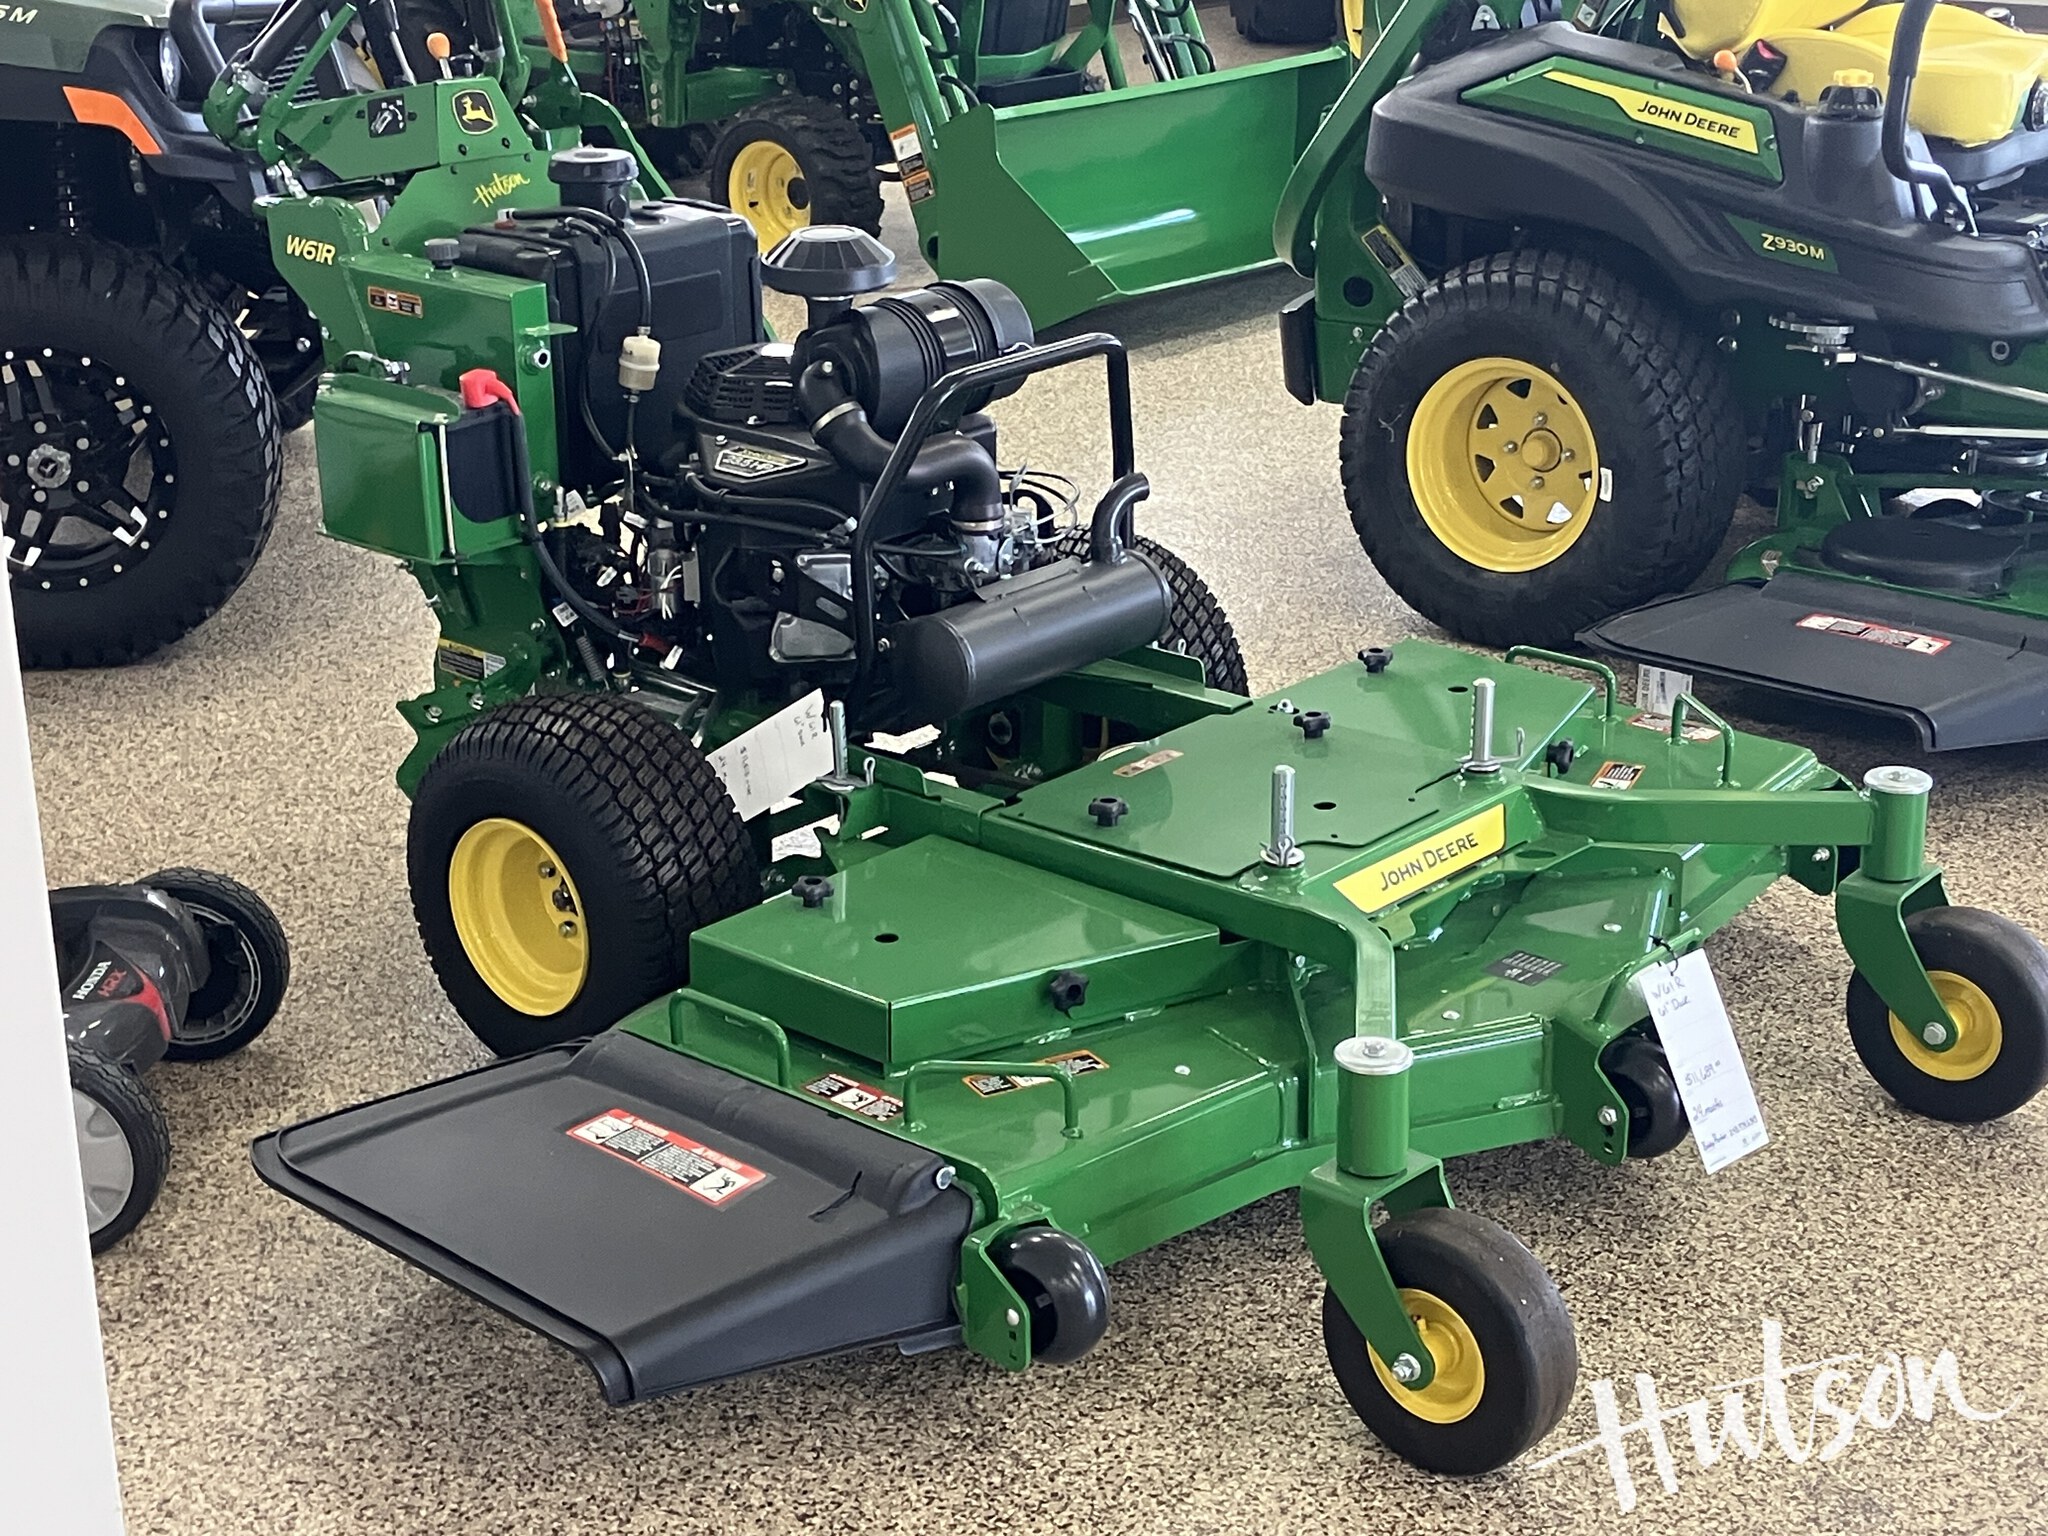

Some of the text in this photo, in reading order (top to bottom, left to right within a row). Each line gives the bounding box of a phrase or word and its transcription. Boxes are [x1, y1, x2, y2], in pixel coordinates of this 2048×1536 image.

[1637, 100, 1741, 139] JOHN DEERE
[472, 172, 531, 208] Hutson
[286, 233, 337, 266] W61R
[1380, 832, 1479, 891] JOHN DEERE
[71, 960, 113, 1000] HONDA
